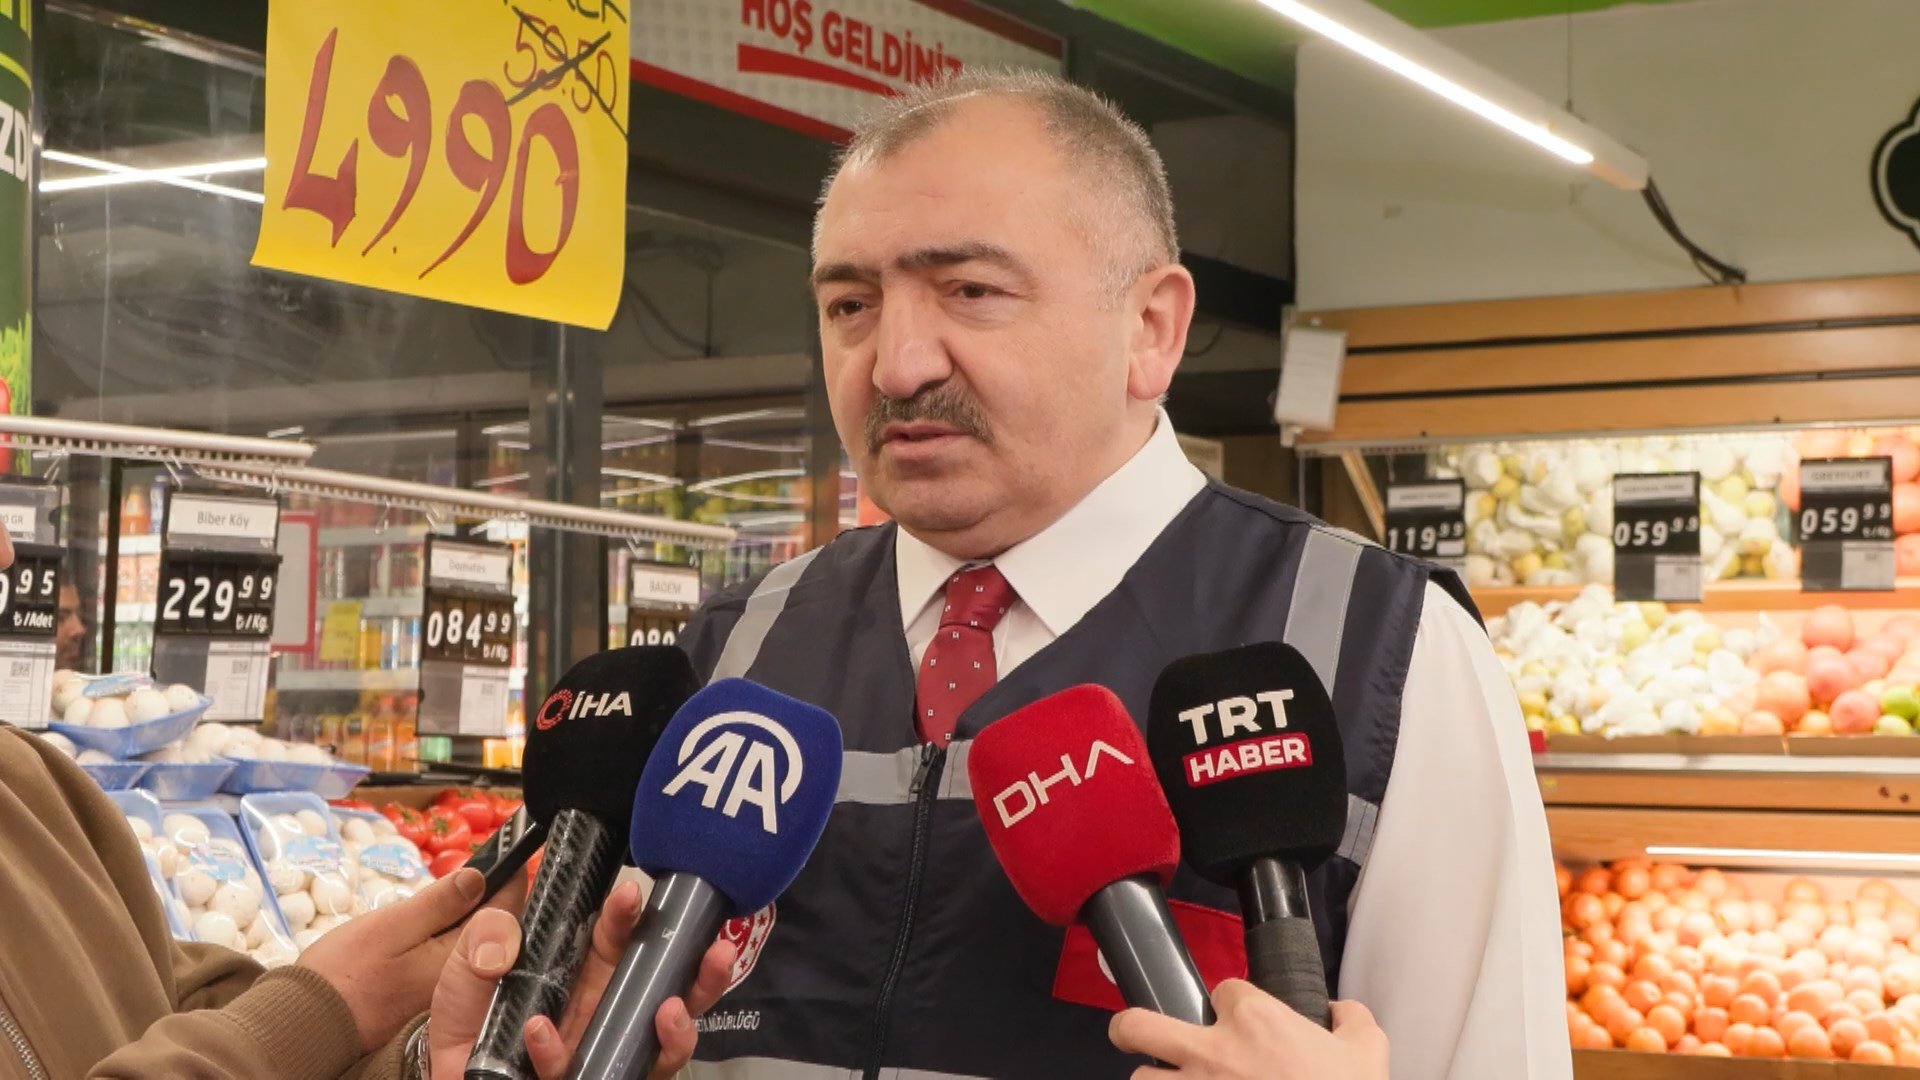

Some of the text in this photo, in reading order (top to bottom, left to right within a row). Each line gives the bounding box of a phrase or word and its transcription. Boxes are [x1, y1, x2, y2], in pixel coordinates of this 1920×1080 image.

[741, 0, 813, 54] HOŞ
[197, 512, 250, 530] Biber Köy
[568, 691, 632, 720] İHA
[1178, 689, 1294, 744] TRT
[662, 731, 777, 834] AA
[993, 740, 1135, 828] DHA
[1189, 738, 1307, 782] HABER
